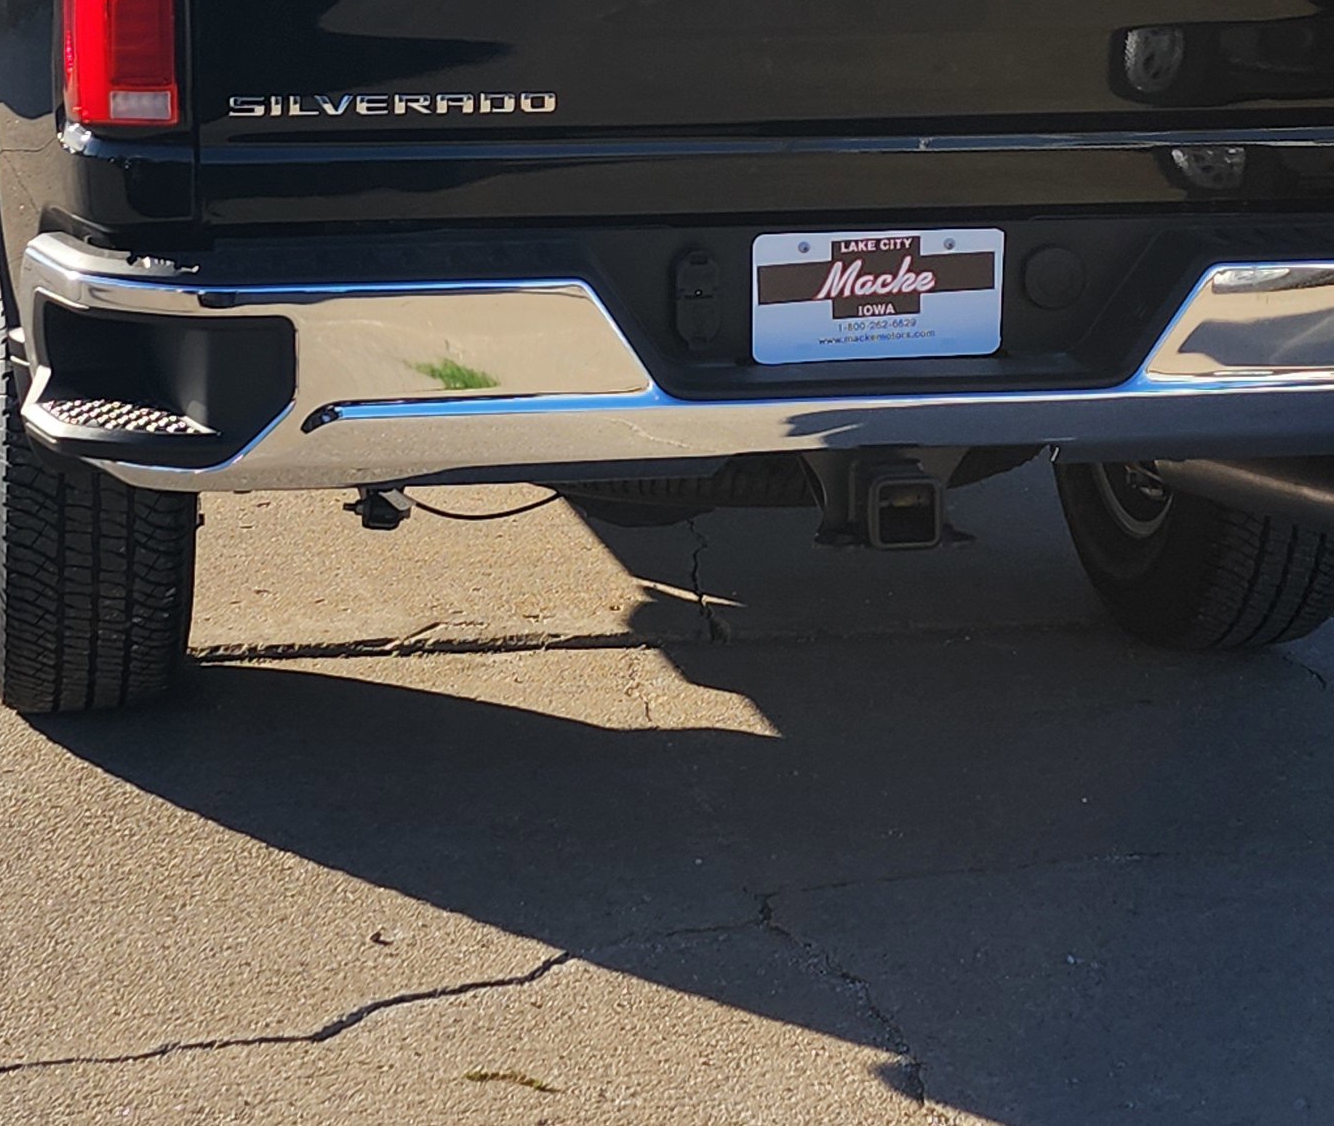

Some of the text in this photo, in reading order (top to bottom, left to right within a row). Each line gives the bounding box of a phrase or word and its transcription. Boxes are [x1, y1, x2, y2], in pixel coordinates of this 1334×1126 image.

[228, 91, 557, 117] SILVERADO
[840, 237, 913, 253] LAKE CITY
[813, 254, 936, 301] Macke
[857, 303, 896, 316] IOWA
[817, 329, 936, 345] www.mackemotors.com
